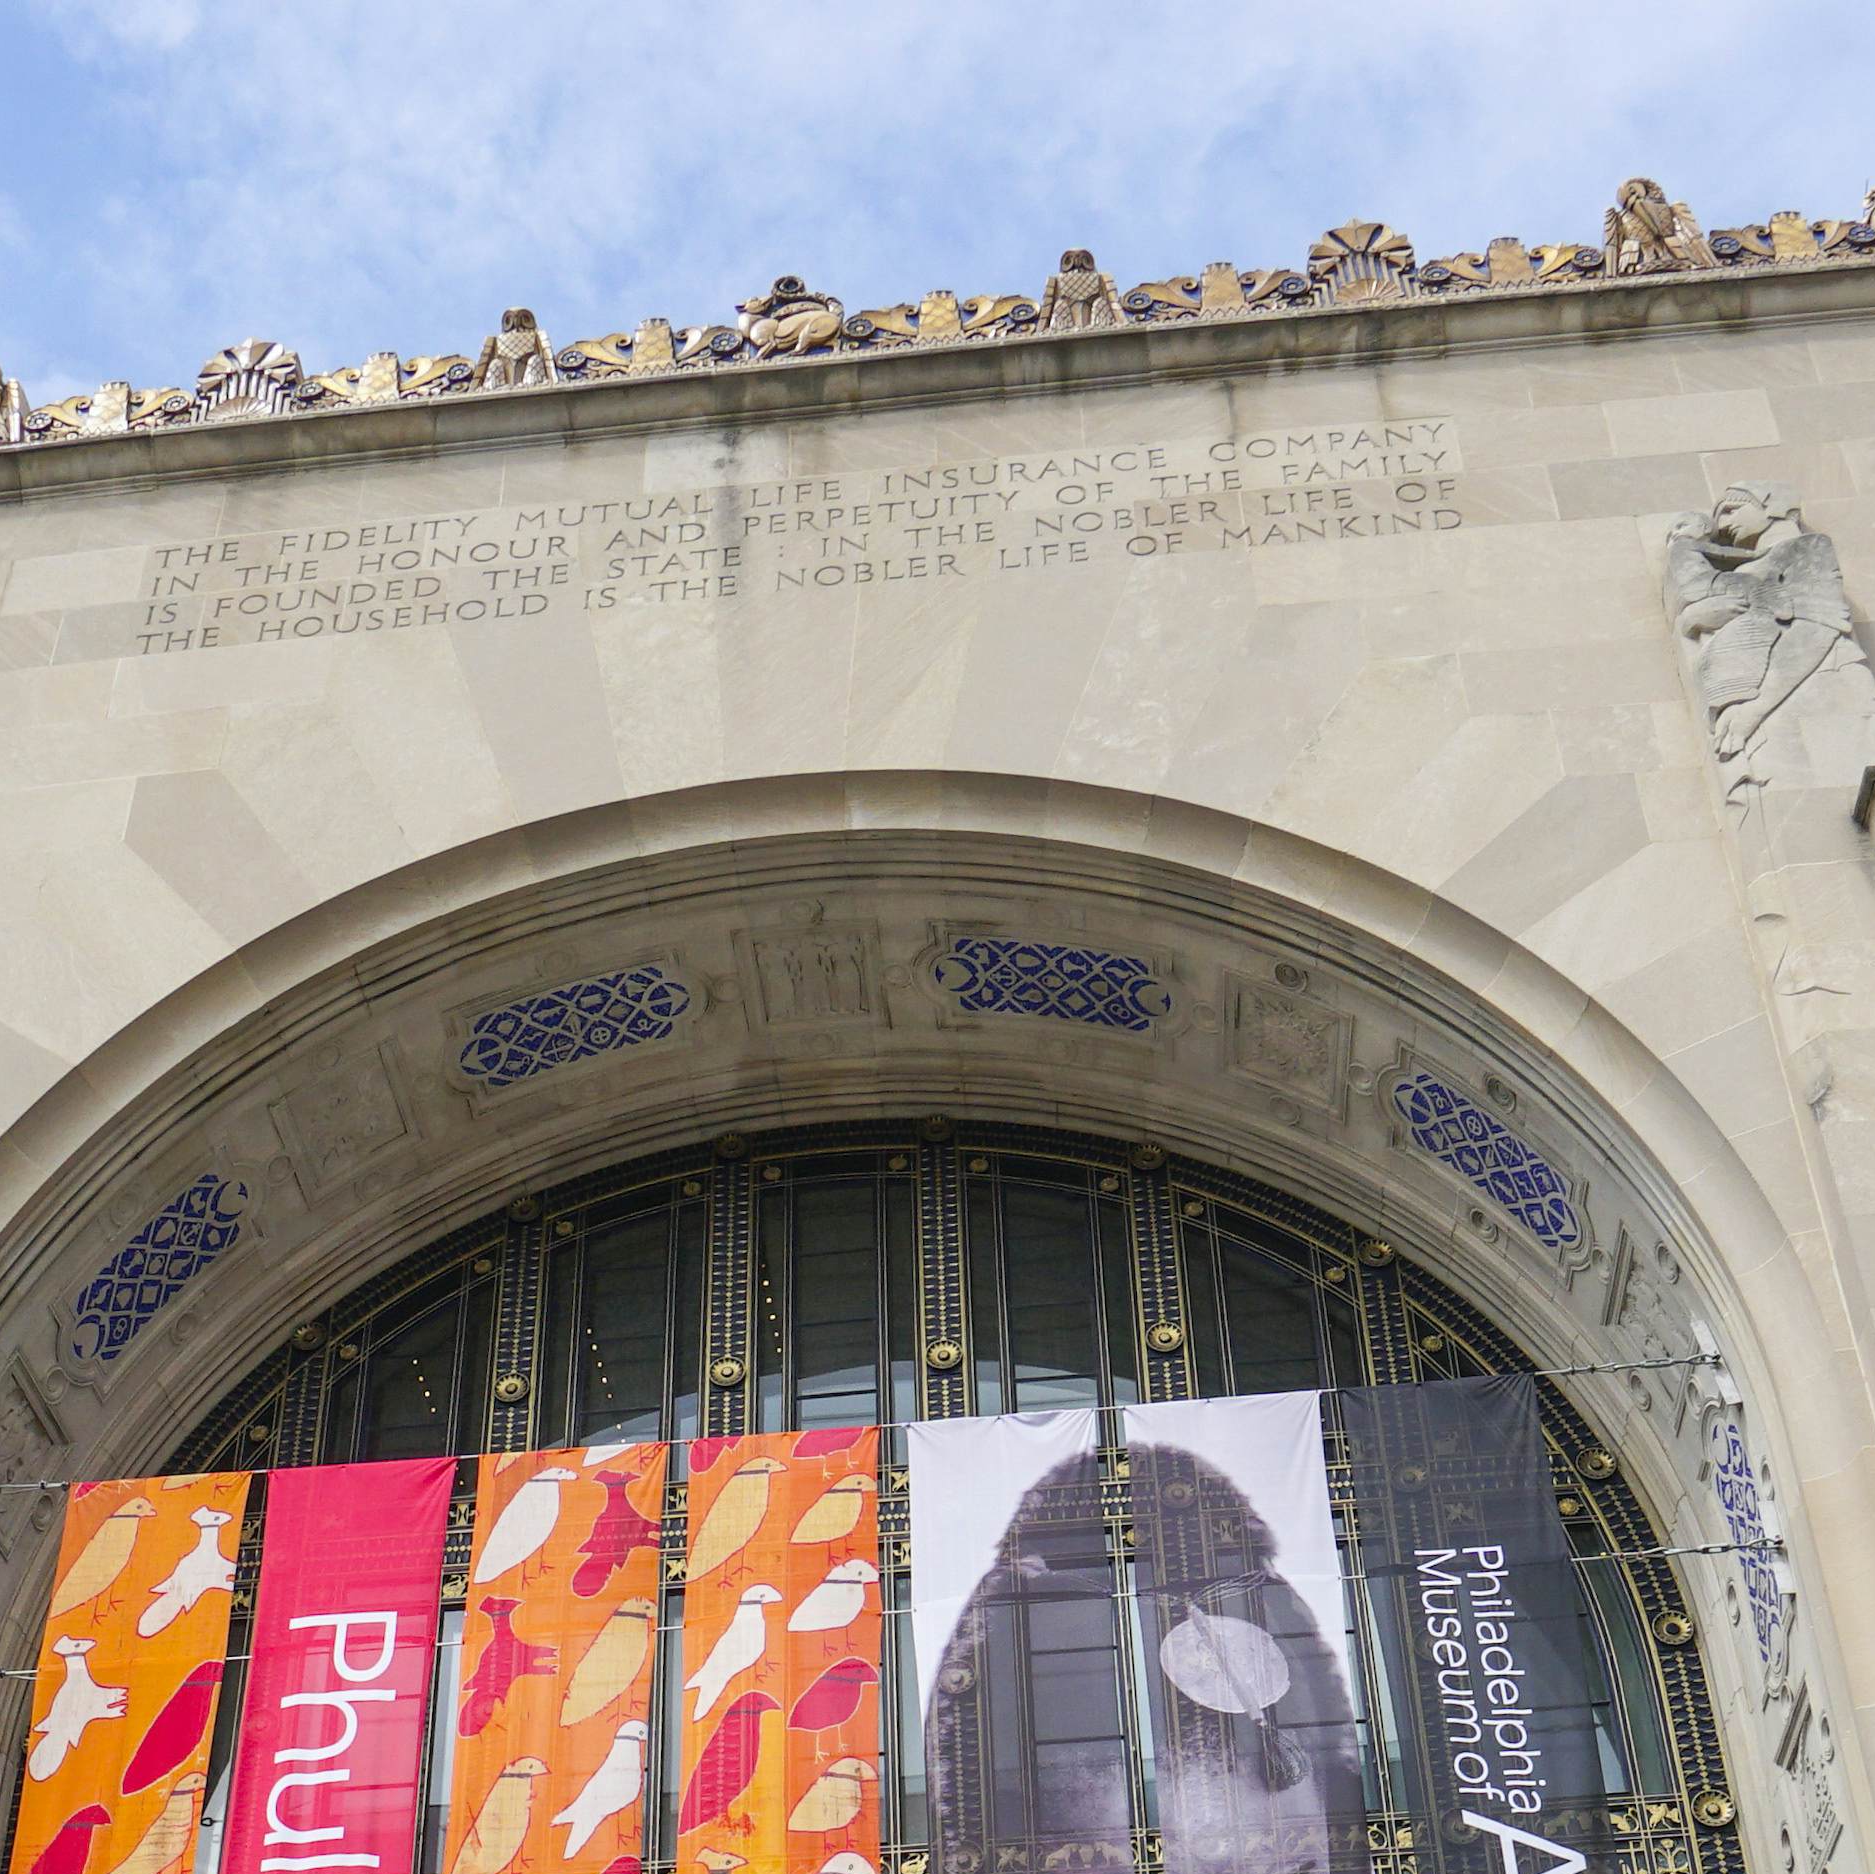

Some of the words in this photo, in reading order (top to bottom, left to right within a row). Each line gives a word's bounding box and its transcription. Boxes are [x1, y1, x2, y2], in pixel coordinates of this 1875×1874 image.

[145, 602, 178, 626] IS
[214, 576, 442, 619] FOUNDED
[483, 564, 570, 592] THE
[607, 545, 742, 579] STATE
[821, 533, 870, 559] IN
[904, 522, 997, 550] THE
[1034, 500, 1226, 538] NOBLER
[1262, 487, 1354, 516] LIFE
[1396, 478, 1457, 503] OF
[151, 572, 201, 597] IN
[234, 559, 320, 588] THE
[357, 536, 570, 575] HONOUR
[605, 523, 706, 552] AND
[743, 490, 1021, 538] PERPETUITY
[1055, 481, 1115, 506] OF
[1150, 469, 1244, 499] THE
[1281, 451, 1450, 485] FAMILY
[156, 541, 240, 569] THE
[279, 515, 478, 556] FIDELITY
[516, 493, 714, 530] MUTUAL
[749, 480, 843, 508] LIFE
[883, 447, 1169, 494] INSURANCE
[1209, 422, 1448, 463] COMPANY
[137, 626, 221, 654] THE
[257, 594, 548, 644] HOUSEHOLD
[582, 586, 617, 611] IS
[648, 575, 737, 603] THE
[776, 554, 965, 592] NOBLER
[999, 541, 1090, 570] LIFE
[1126, 531, 1185, 556] OF
[1221, 509, 1464, 550] MANKIND
[1413, 1547, 1483, 1745] Museum
[1453, 1751, 1506, 1802] of
[1461, 1544, 1546, 1814] Philadelphia
